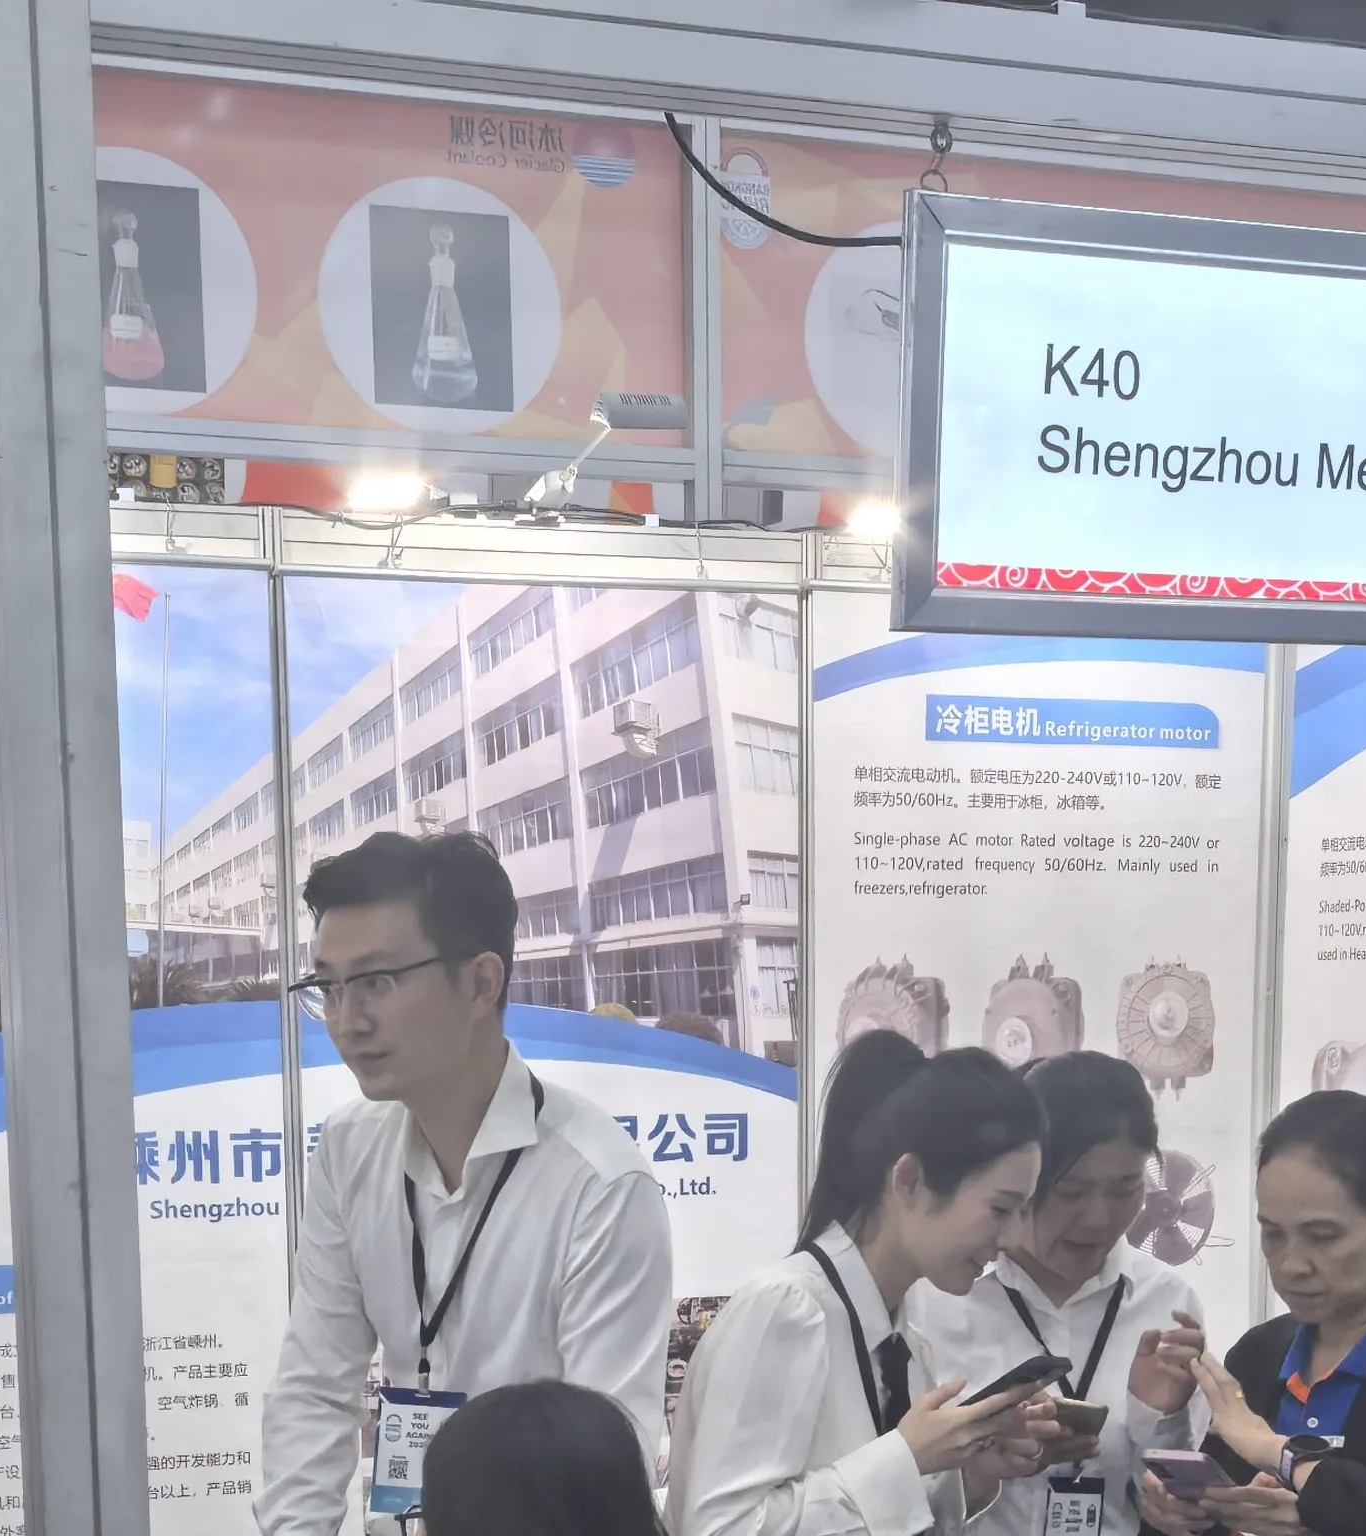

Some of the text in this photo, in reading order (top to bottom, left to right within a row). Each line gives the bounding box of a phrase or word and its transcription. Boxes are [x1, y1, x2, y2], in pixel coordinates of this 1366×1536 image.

[1045, 344, 1140, 400] K40
[1038, 425, 1298, 492] Shengzhou
[936, 704, 1210, 741] 冷柜电机 Refrigerator motor
[855, 832, 940, 850] Single-phase
[949, 832, 967, 846] AC
[1021, 834, 1055, 847] Rated
[1063, 834, 1115, 851] voltage
[1123, 834, 1131, 848] is
[1207, 840, 1220, 848] or
[975, 856, 1035, 874] frequency
[1118, 858, 1161, 875] Mainly
[1169, 860, 1197, 872] used
[1208, 860, 1219, 872] in
[151, 1197, 279, 1223] Shengzhou
